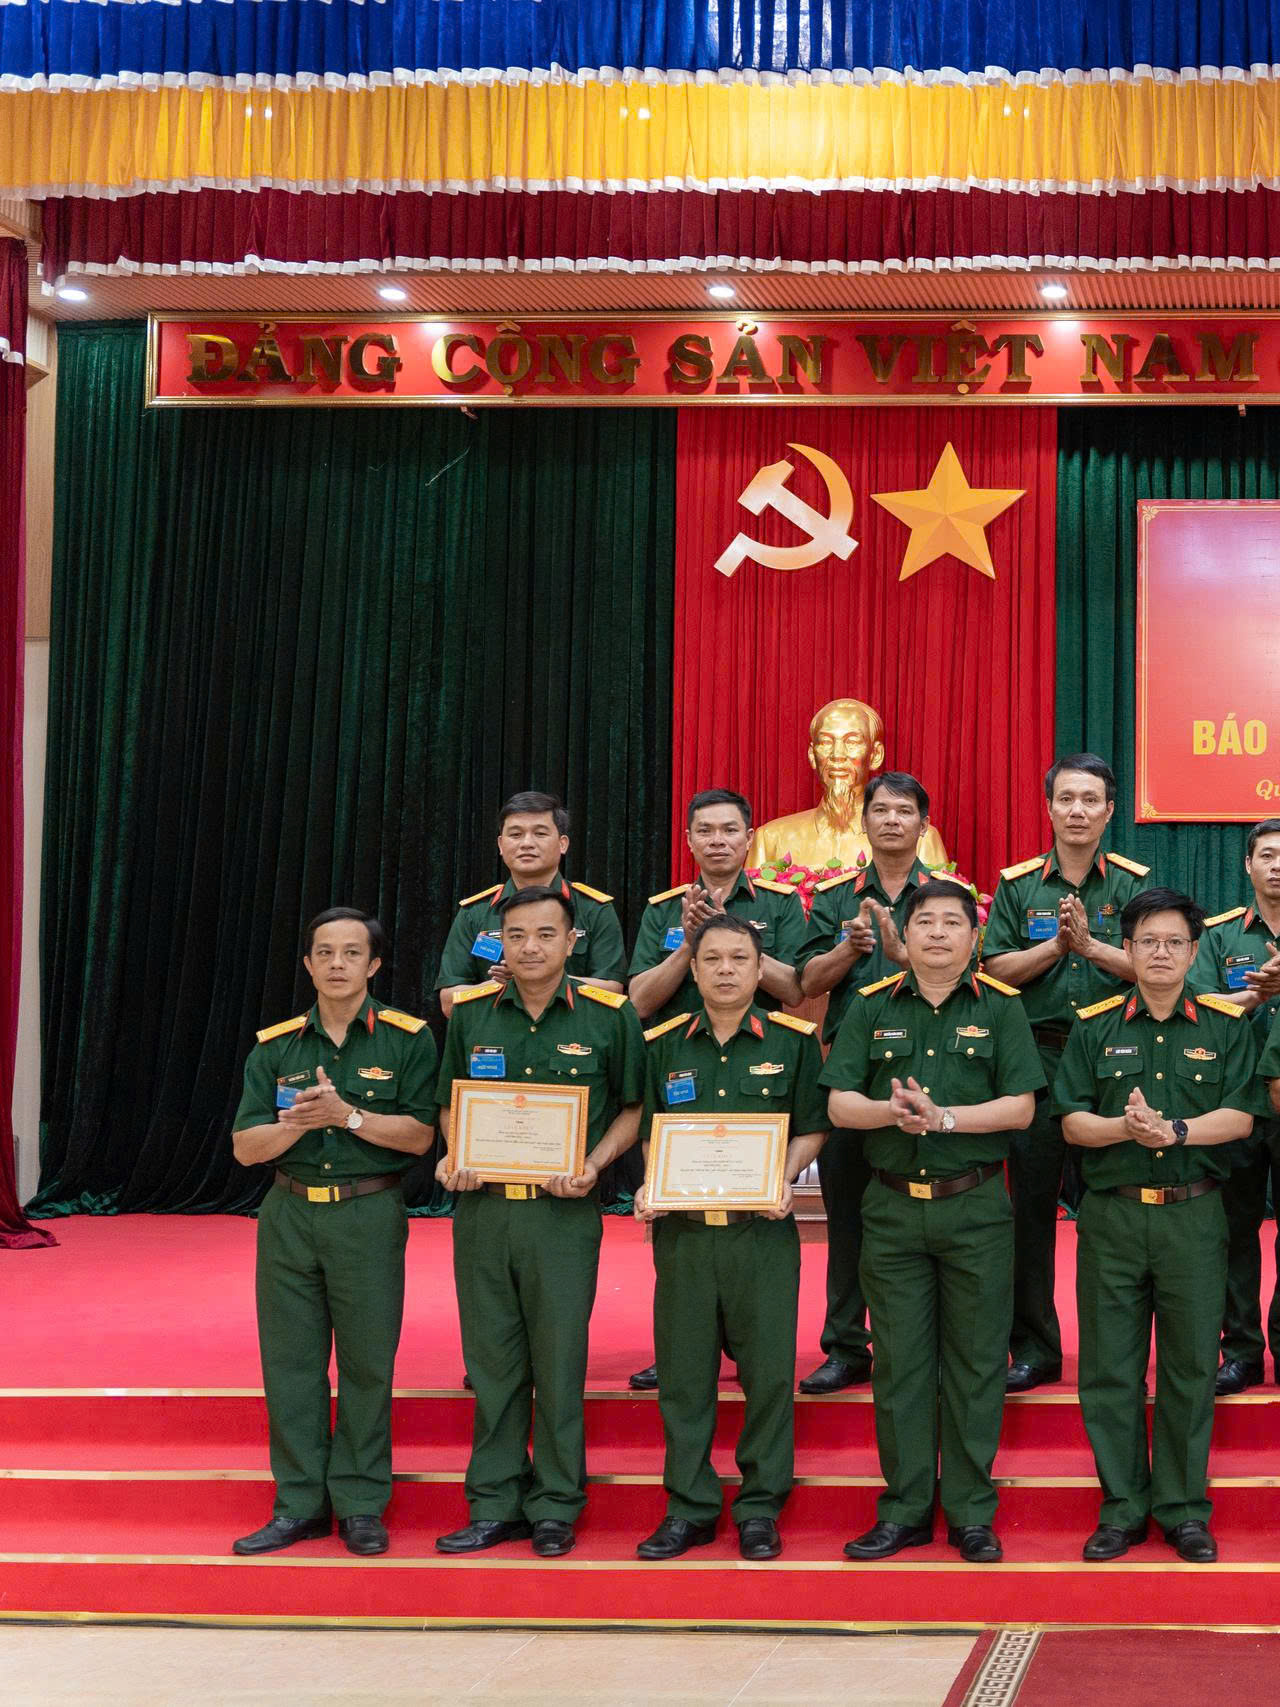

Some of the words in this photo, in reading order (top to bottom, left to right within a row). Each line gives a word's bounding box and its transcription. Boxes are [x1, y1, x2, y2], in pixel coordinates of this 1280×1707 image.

[185, 321, 402, 384] ĐẢNG
[431, 320, 641, 396] CỘNG
[670, 319, 829, 385] SẢN
[855, 319, 1045, 395] VIỆT
[1079, 332, 1261, 383] NAM
[1193, 712, 1268, 756] BÁO
